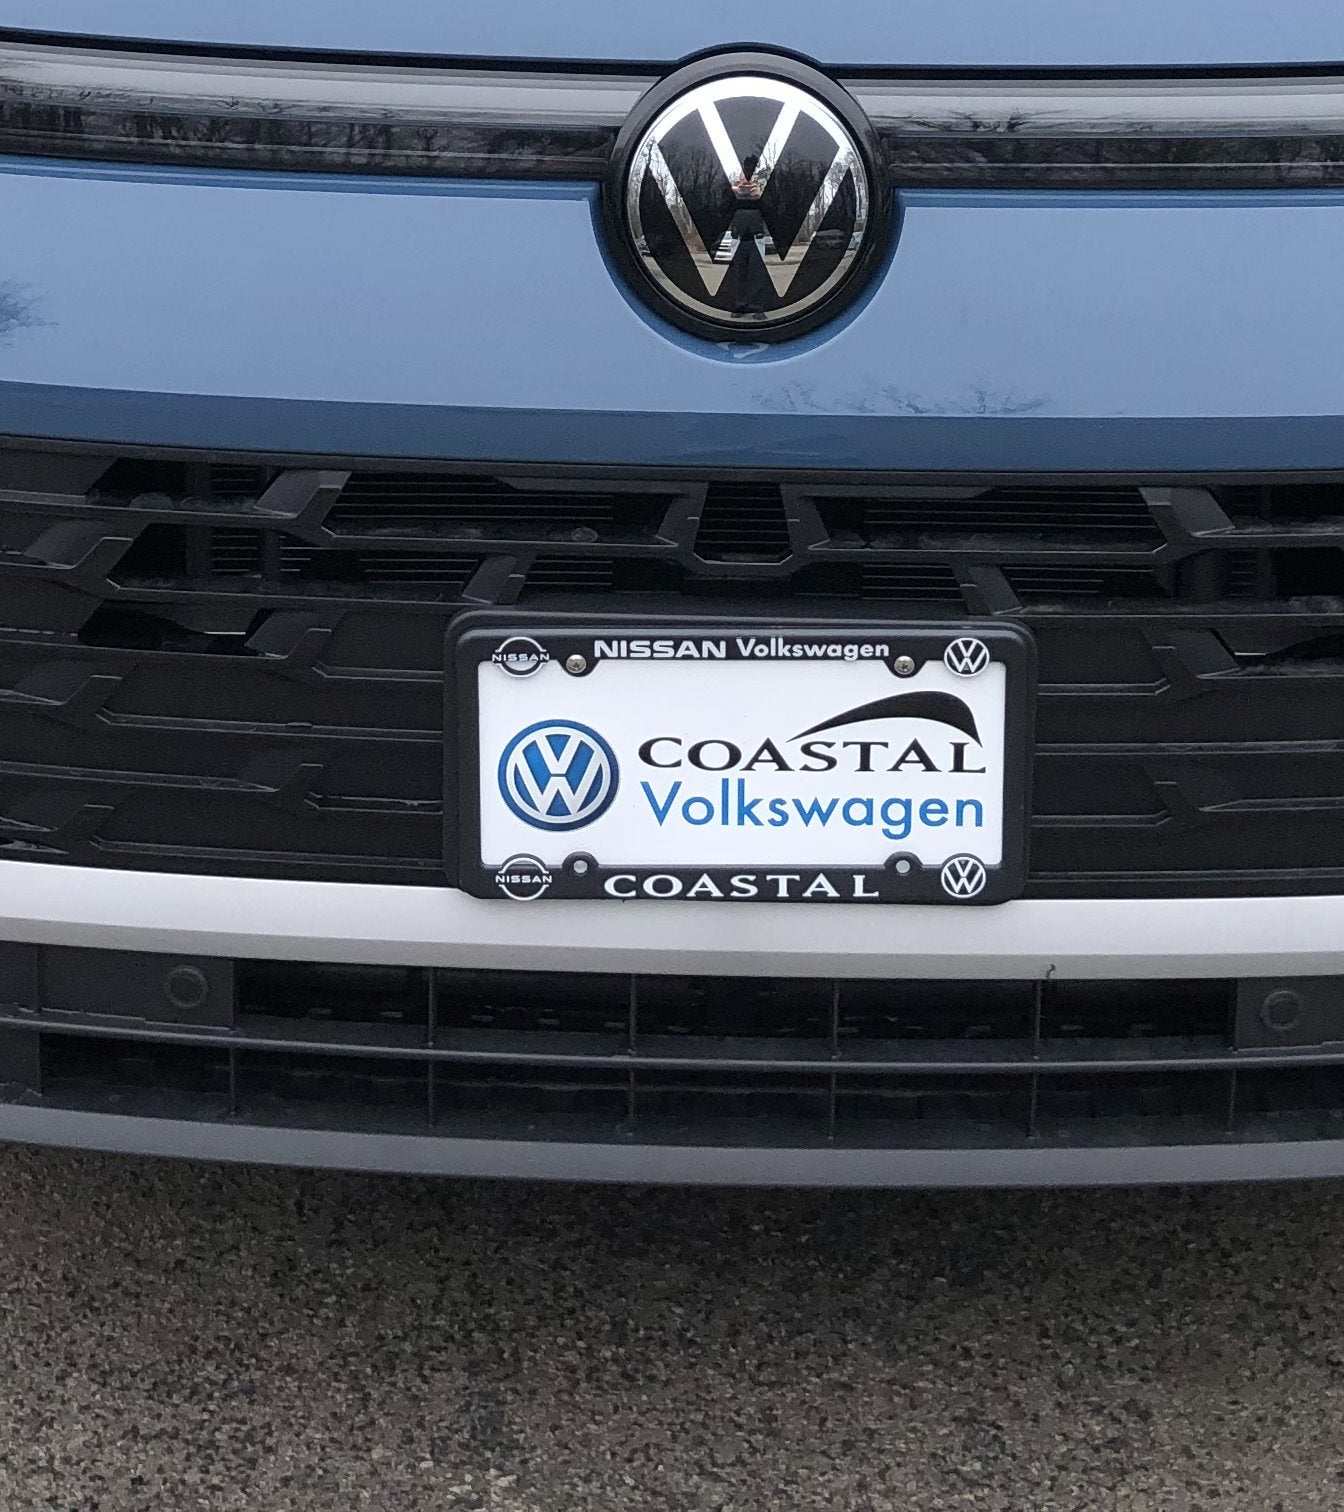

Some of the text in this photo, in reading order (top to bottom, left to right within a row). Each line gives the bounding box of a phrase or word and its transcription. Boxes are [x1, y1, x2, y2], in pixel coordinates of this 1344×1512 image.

[491, 653, 550, 662] NISSAN
[594, 637, 890, 662] NISSAN Volkswagen
[638, 737, 987, 774] COASTAL
[640, 778, 984, 840] Volkswagen
[495, 874, 553, 884] NISSAN
[603, 872, 881, 898] COASTAL
